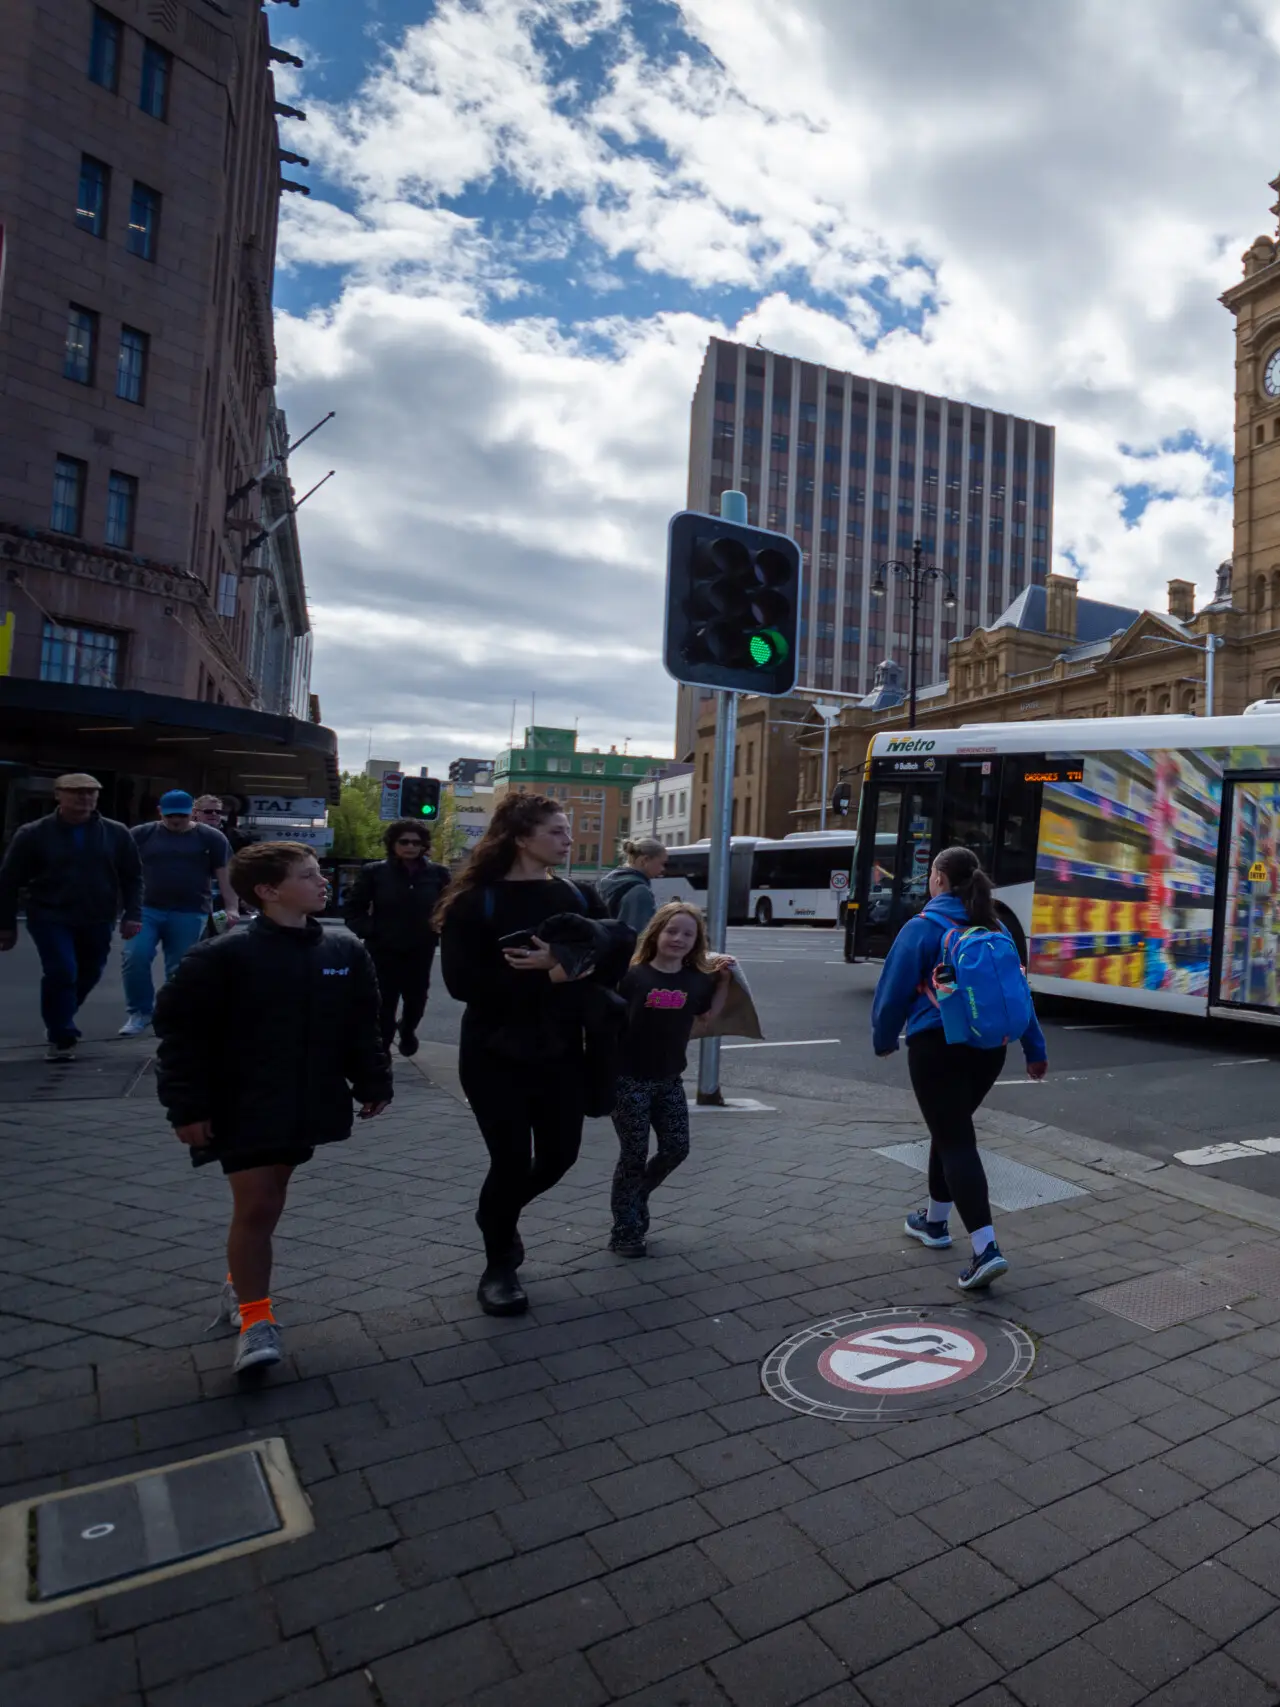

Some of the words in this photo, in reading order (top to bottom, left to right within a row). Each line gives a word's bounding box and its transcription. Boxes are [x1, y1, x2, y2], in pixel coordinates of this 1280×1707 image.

[886, 736, 936, 752] Metro
[456, 805, 485, 813] Kodak
[834, 877, 845, 885] 30
